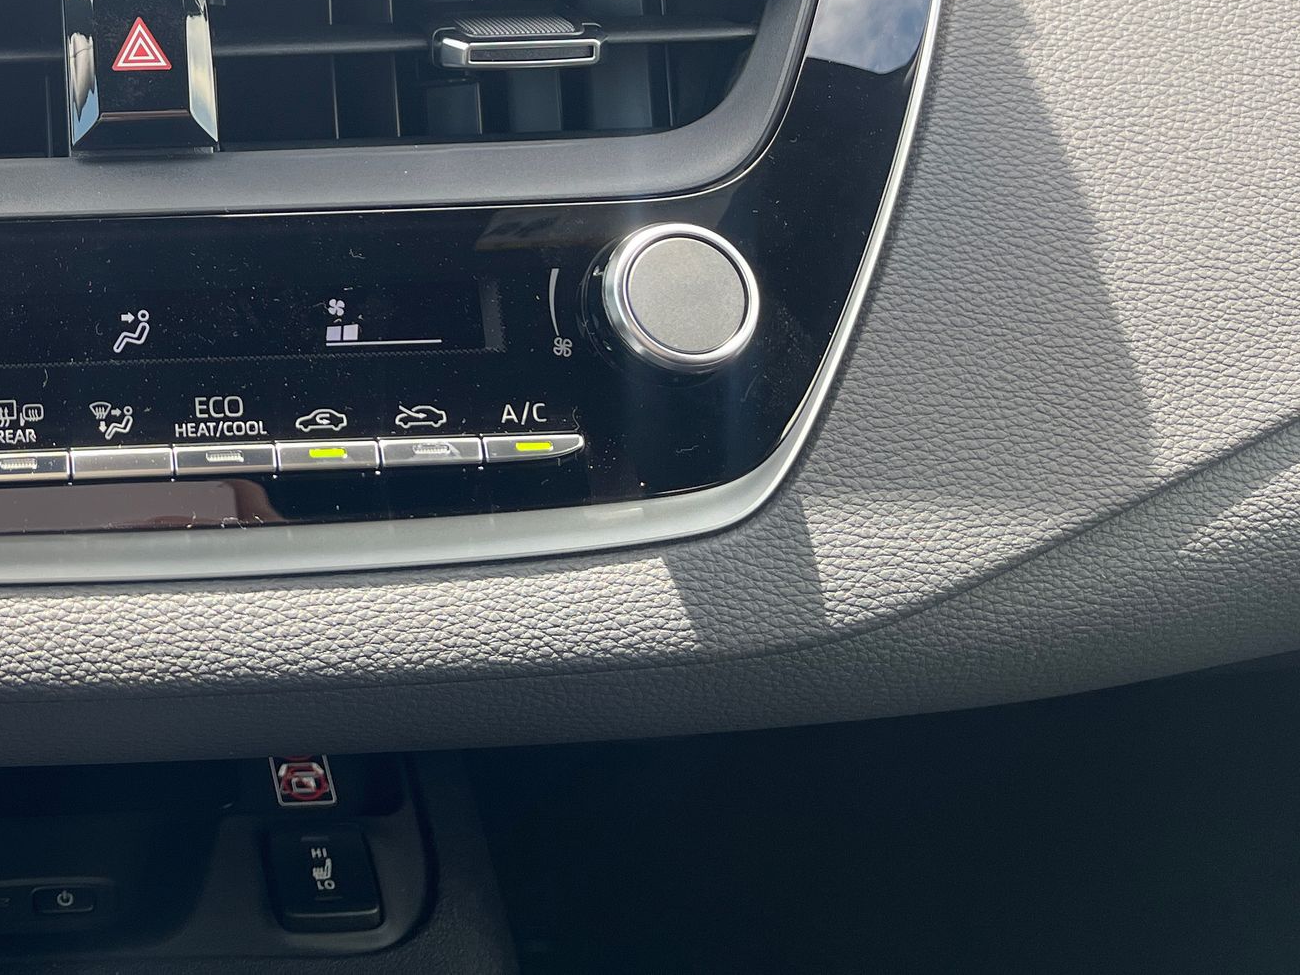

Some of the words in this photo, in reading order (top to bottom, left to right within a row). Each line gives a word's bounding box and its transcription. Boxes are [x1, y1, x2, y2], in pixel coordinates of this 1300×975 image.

[194, 396, 244, 418] ECO
[501, 402, 547, 423] A/C
[175, 421, 268, 438] HEAT/COOL
[311, 847, 327, 858] HI
[317, 880, 336, 890] LO
